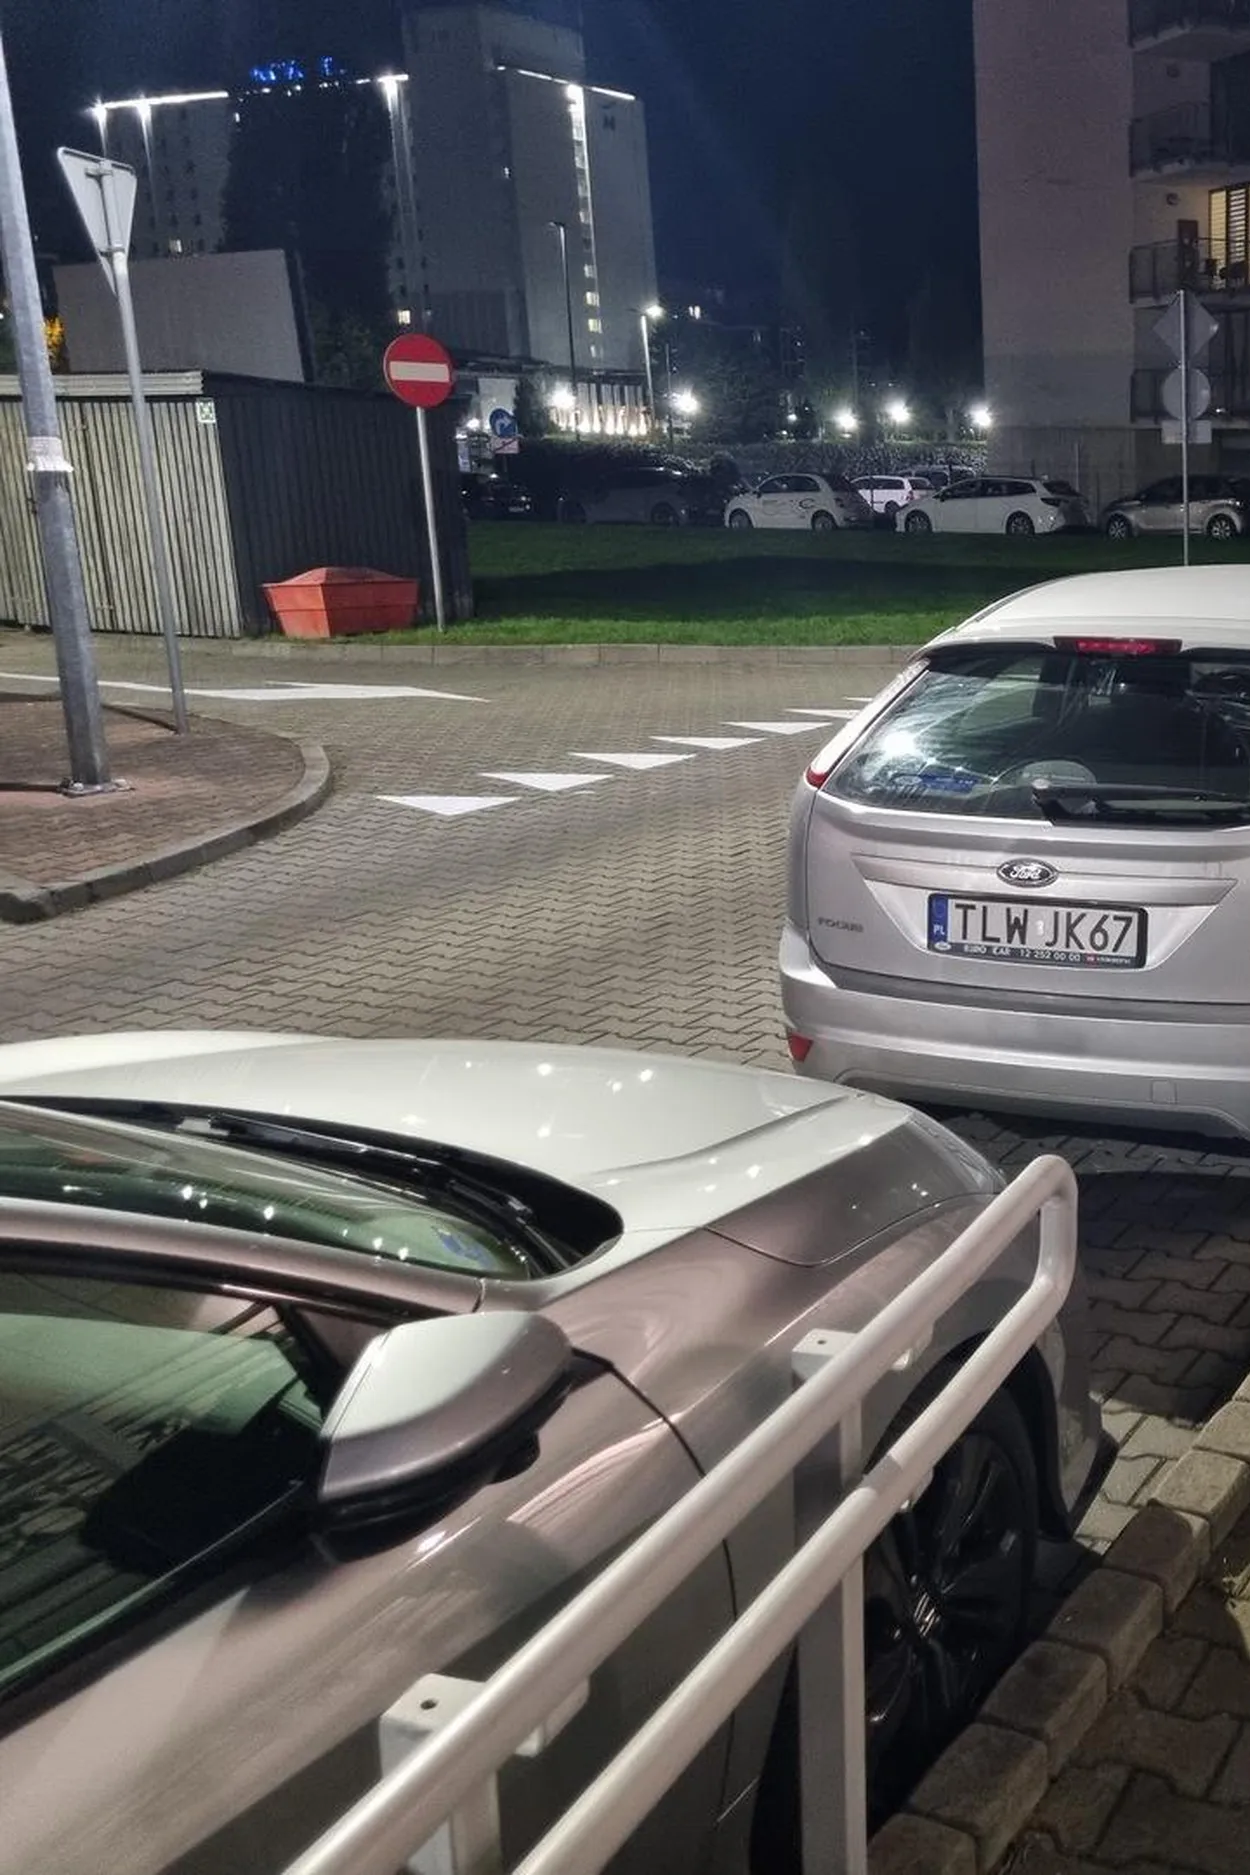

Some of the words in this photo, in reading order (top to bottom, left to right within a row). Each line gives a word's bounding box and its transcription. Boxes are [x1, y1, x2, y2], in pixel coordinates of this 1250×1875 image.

[1010, 863, 1042, 879] Ford
[934, 925, 945, 935] PL
[954, 903, 1028, 945] TLW
[1045, 911, 1133, 952] JK67
